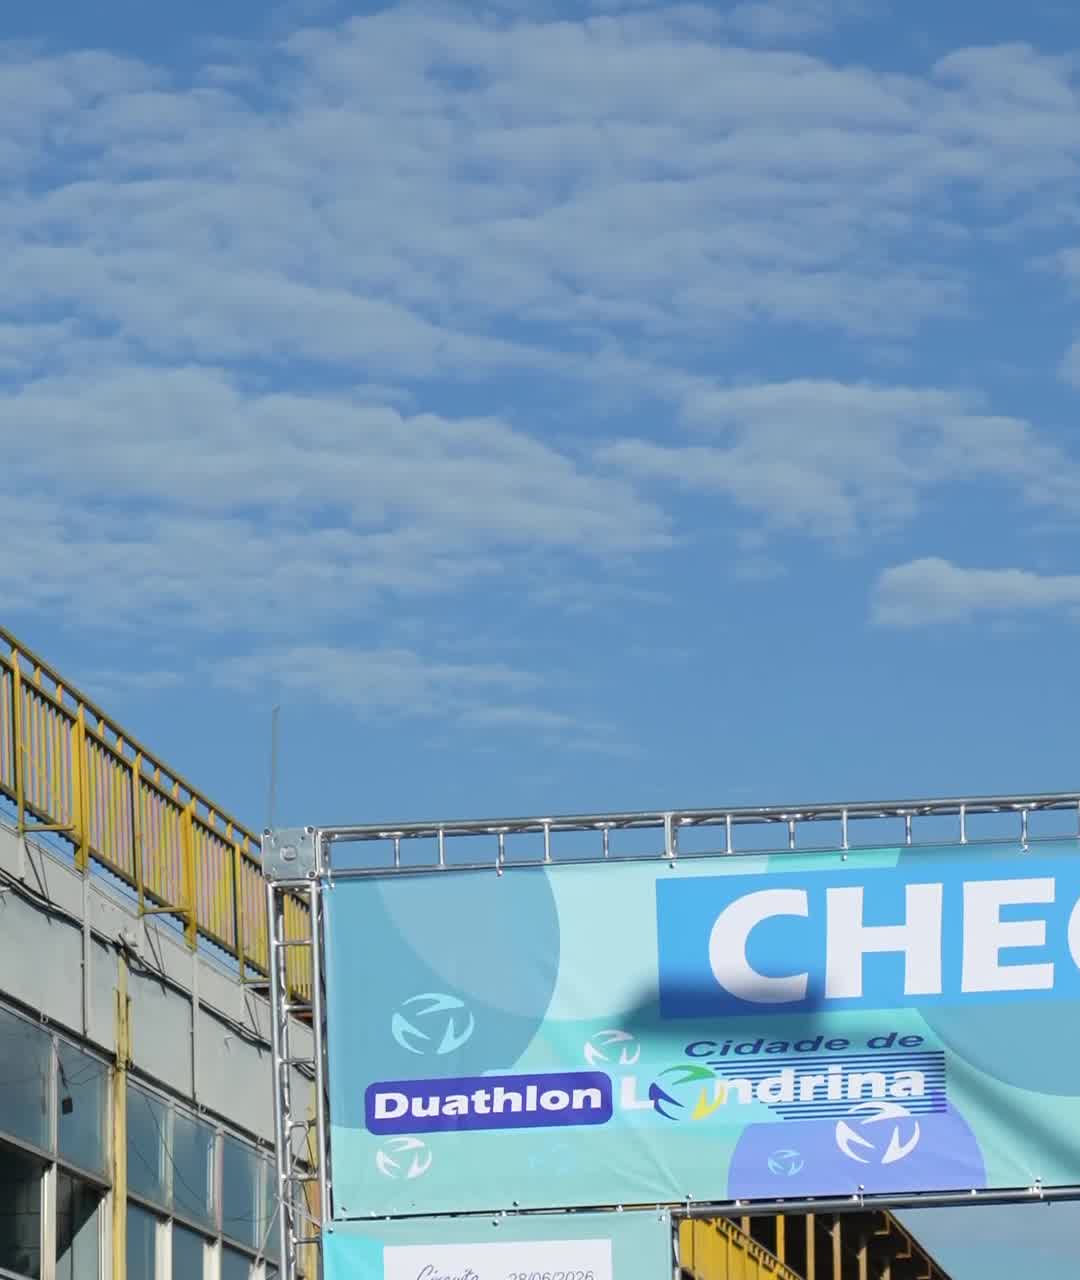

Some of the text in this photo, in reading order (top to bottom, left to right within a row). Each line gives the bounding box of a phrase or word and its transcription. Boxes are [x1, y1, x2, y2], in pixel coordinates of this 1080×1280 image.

[684, 1031, 925, 1058] Cidade de
[373, 1078, 602, 1121] Duathlon
